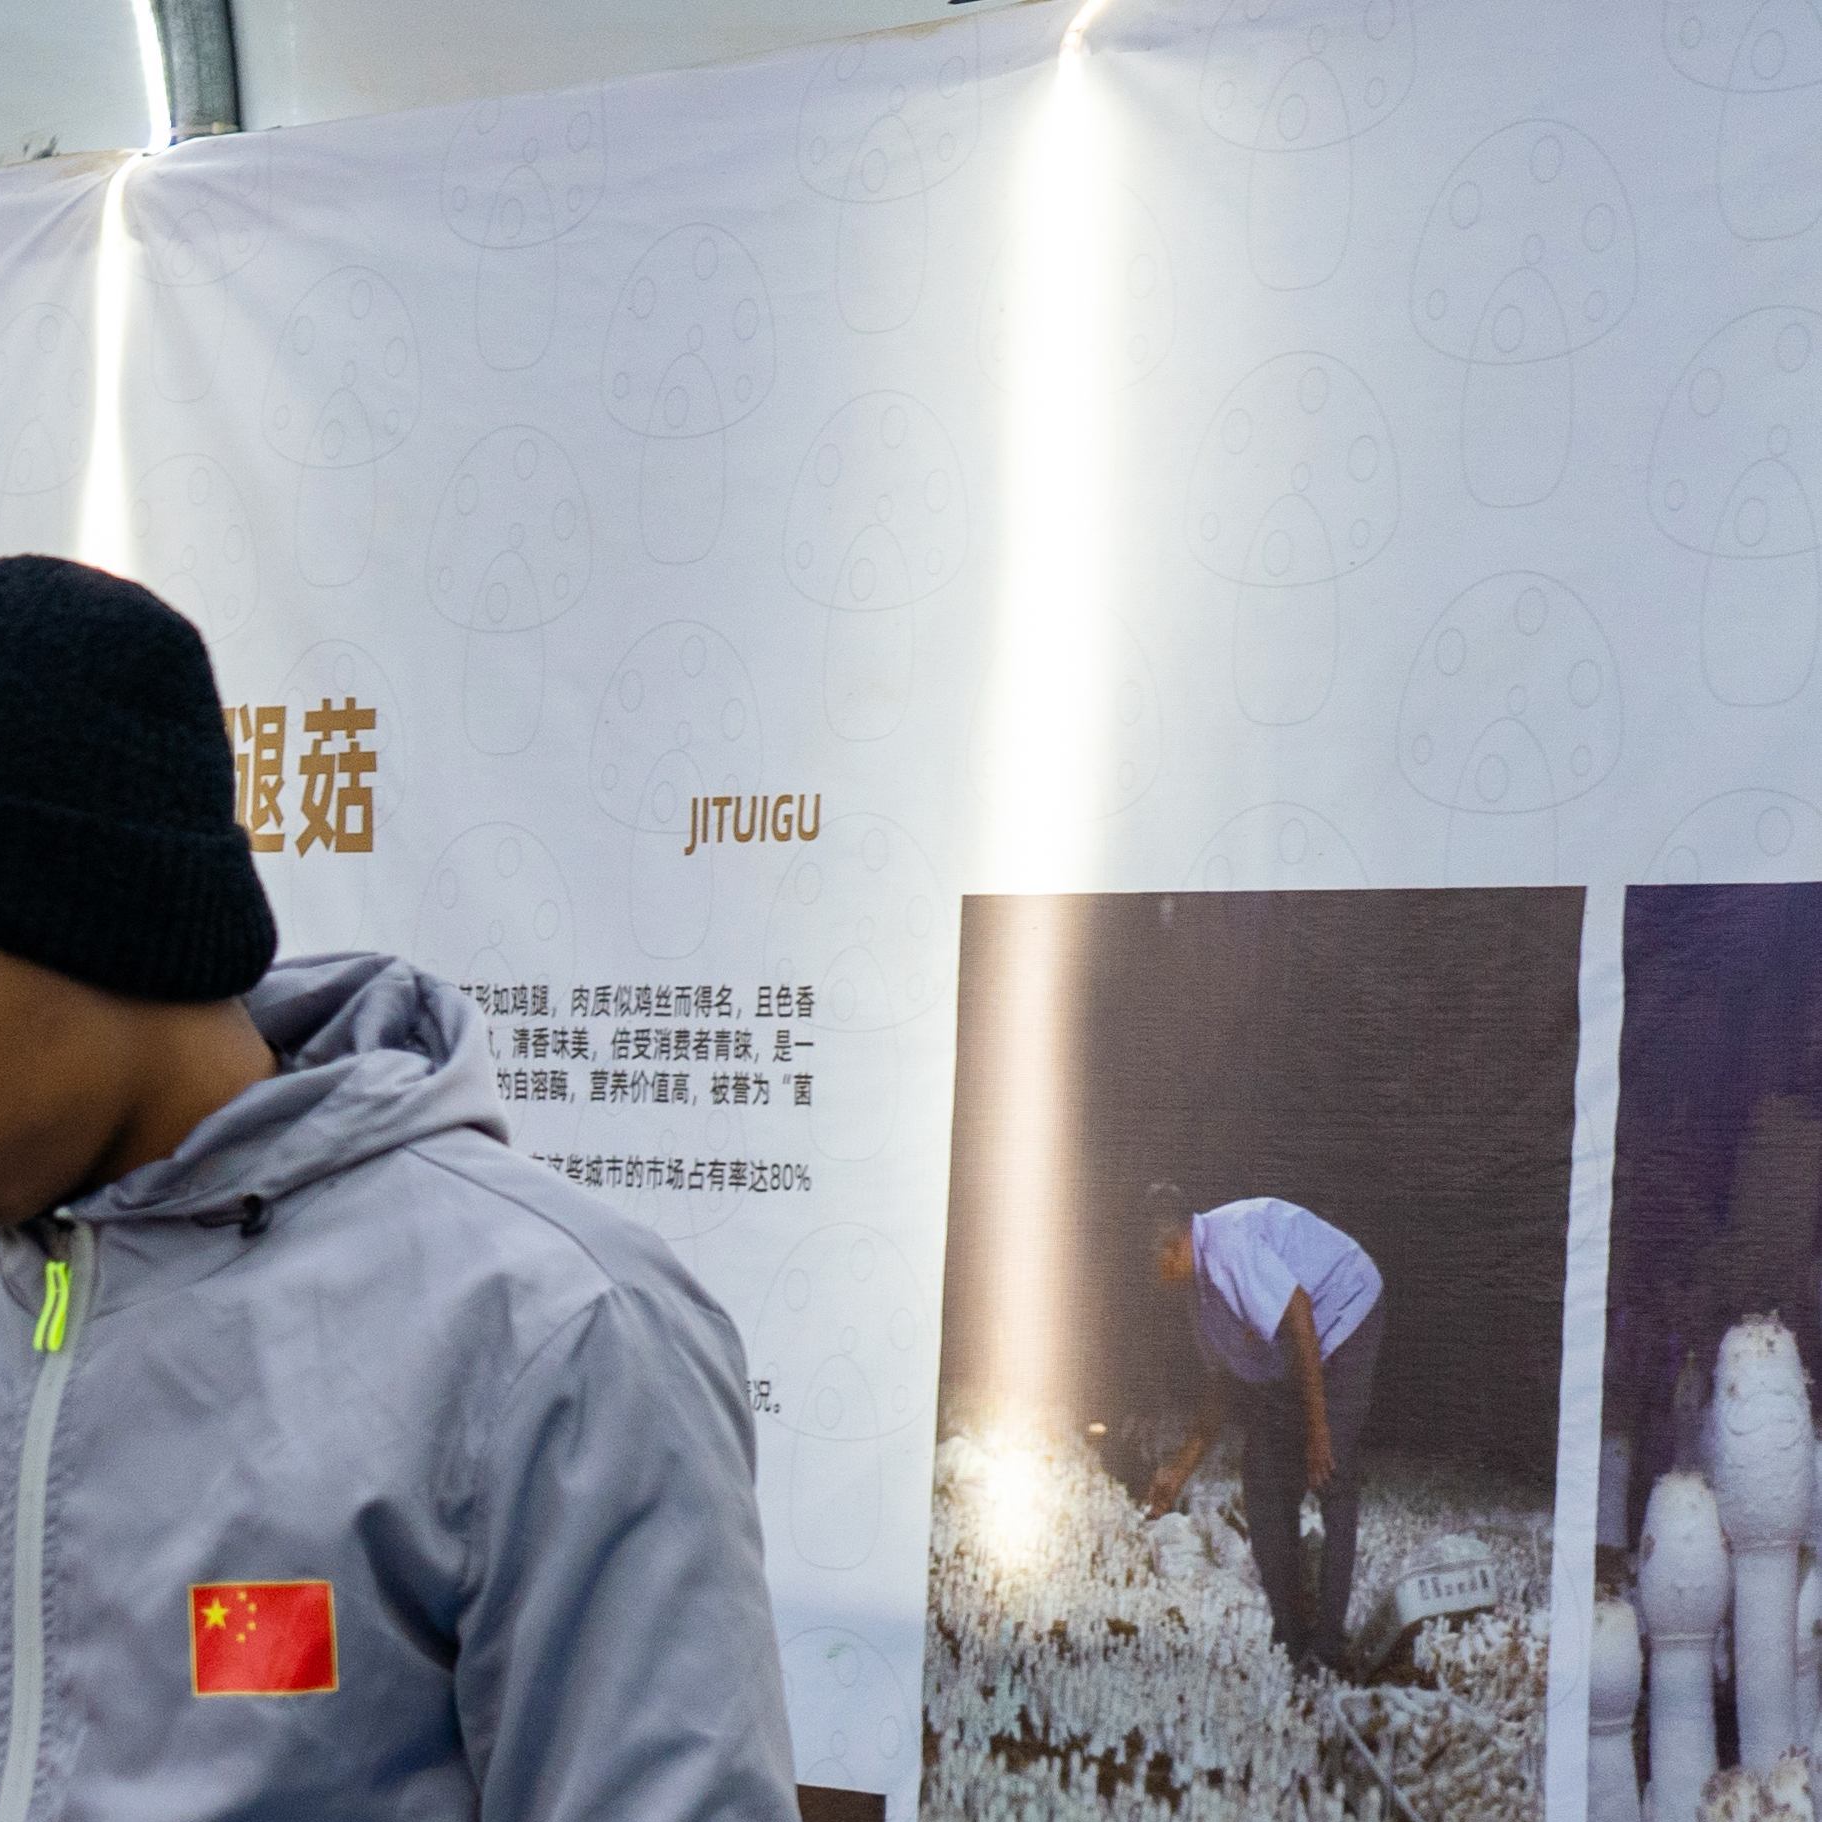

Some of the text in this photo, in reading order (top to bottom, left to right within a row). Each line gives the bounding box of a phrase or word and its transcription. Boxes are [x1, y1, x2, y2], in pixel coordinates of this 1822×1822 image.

[684, 793, 821, 856] JITUIGU
[488, 1026, 814, 1063] ，清香味美，倍受消费者青睐，是一
[529, 1153, 812, 1193] 些城市的市场占有率达80%
